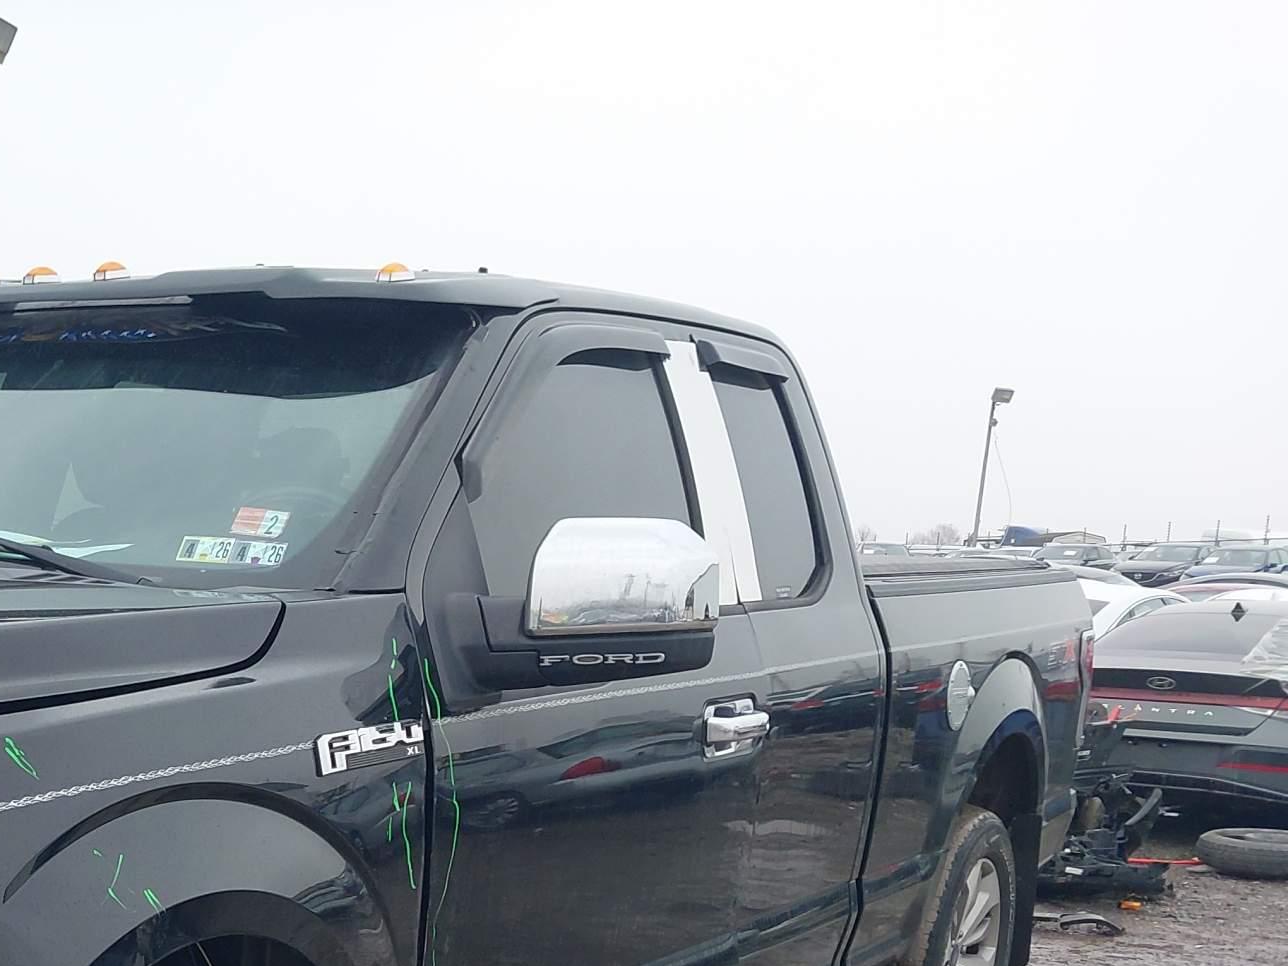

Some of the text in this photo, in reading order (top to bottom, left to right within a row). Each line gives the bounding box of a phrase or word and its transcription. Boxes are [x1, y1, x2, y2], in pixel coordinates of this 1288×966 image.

[264, 515, 279, 535] 2
[185, 543, 196, 559] 4
[237, 546, 248, 562] 4
[539, 652, 665, 666] FORD
